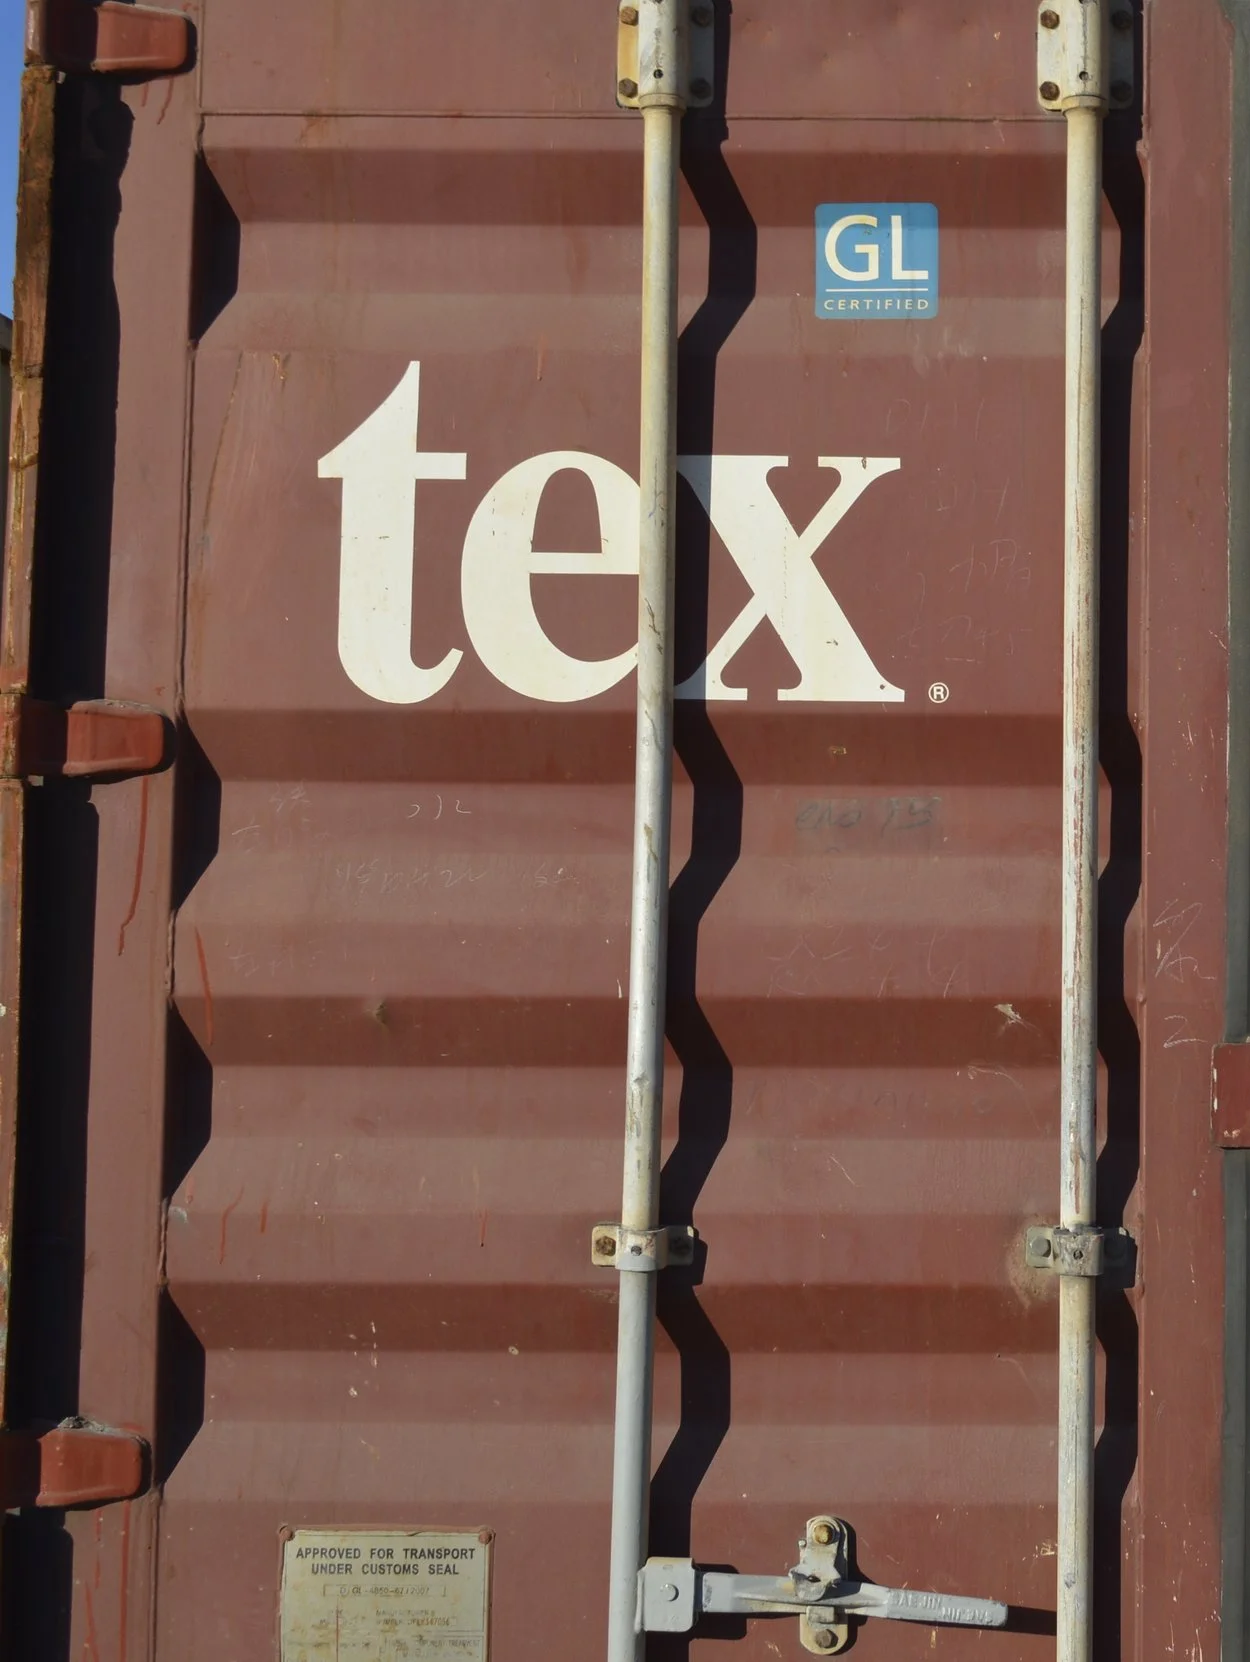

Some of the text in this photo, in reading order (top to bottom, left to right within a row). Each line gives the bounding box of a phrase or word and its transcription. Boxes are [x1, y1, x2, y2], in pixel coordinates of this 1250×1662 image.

[825, 214, 928, 282] GL
[824, 299, 928, 310] CERTIFIED
[318, 361, 905, 703] tex
[296, 1548, 475, 1559] APPROVED FOR TRANSPORT
[311, 1564, 459, 1575] UNDER CUSTOMS SEAL
